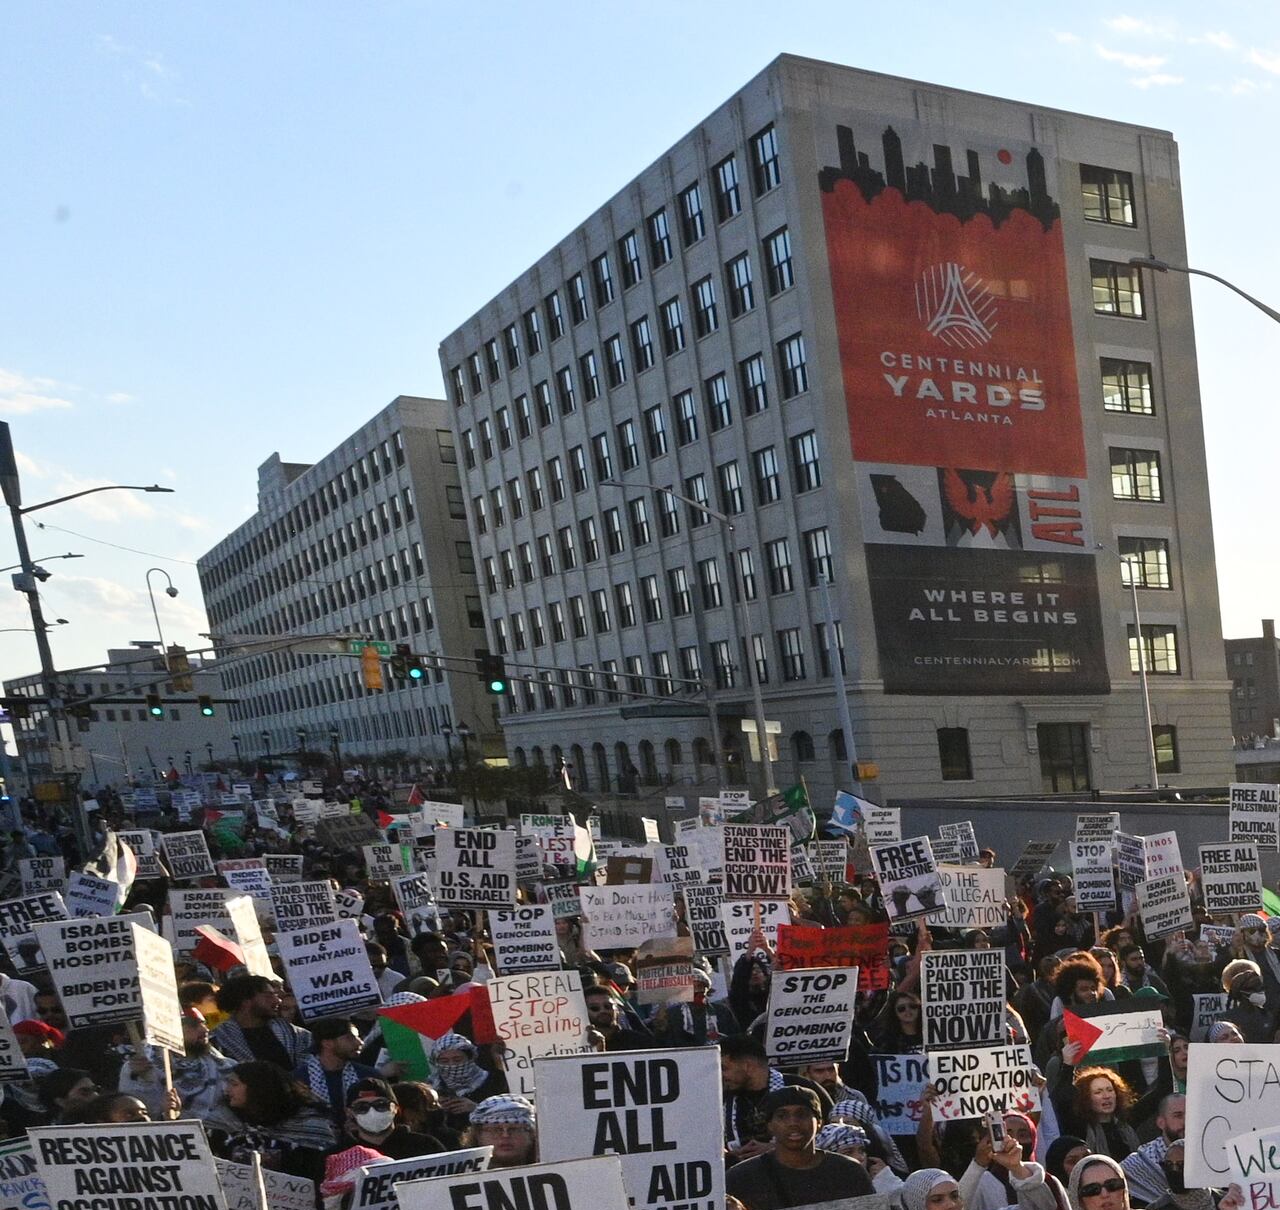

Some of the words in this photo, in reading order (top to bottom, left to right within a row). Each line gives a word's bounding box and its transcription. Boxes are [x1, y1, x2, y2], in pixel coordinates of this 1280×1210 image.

[880, 351, 1044, 384] CENTENNIAL
[883, 374, 1046, 412] YARDS
[925, 408, 1014, 426] ATLANTA
[1032, 484, 1084, 547] ATL
[923, 588, 1025, 606] WHERE
[1037, 592, 1060, 606] IT
[908, 608, 962, 624] ALL
[974, 609, 1079, 626] BEGINS
[914, 655, 1082, 667] CENTENNIALYARDS.COM
[454, 830, 497, 850] END
[457, 849, 494, 868] ALL
[1201, 849, 1232, 863] FREE
[1233, 848, 1256, 862] ALL
[1203, 861, 1257, 875] PALESTINIAN
[440, 871, 477, 889] U.S.
[480, 873, 509, 889] AID
[1205, 881, 1259, 896] POLITICAL
[439, 889, 457, 899] TO
[459, 888, 510, 901] ISRAEL!
[1207, 894, 1261, 906] PRISONERS
[292, 928, 342, 947] BIDEN
[289, 947, 361, 967] NETANYAHU:
[925, 953, 967, 970] STAND
[970, 952, 1000, 966] WITH
[310, 970, 354, 988] WAR
[926, 966, 1001, 983] PALESTINE!
[490, 974, 582, 1003] ISREAL
[783, 974, 848, 994] STOP
[926, 983, 966, 1002] END
[970, 980, 1002, 1000] THE
[302, 983, 371, 1004] CRIMINALS
[802, 993, 825, 1003] THE
[508, 997, 569, 1019] STOP
[774, 1003, 849, 1017] GENOCIDAL
[926, 1002, 1001, 1018] OCCUPATION
[499, 1015, 582, 1041] Stealing
[773, 1021, 847, 1038] BOMBING
[927, 1015, 1000, 1044] NOW!
[775, 1038, 799, 1051] OF
[799, 1036, 842, 1050] GAZA!
[937, 1055, 979, 1074] END
[991, 1049, 1028, 1067] THE
[934, 1072, 1032, 1096] OCCUPATION
[38, 1133, 200, 1165] RESISTANCE
[74, 1165, 183, 1195] AGAINST
